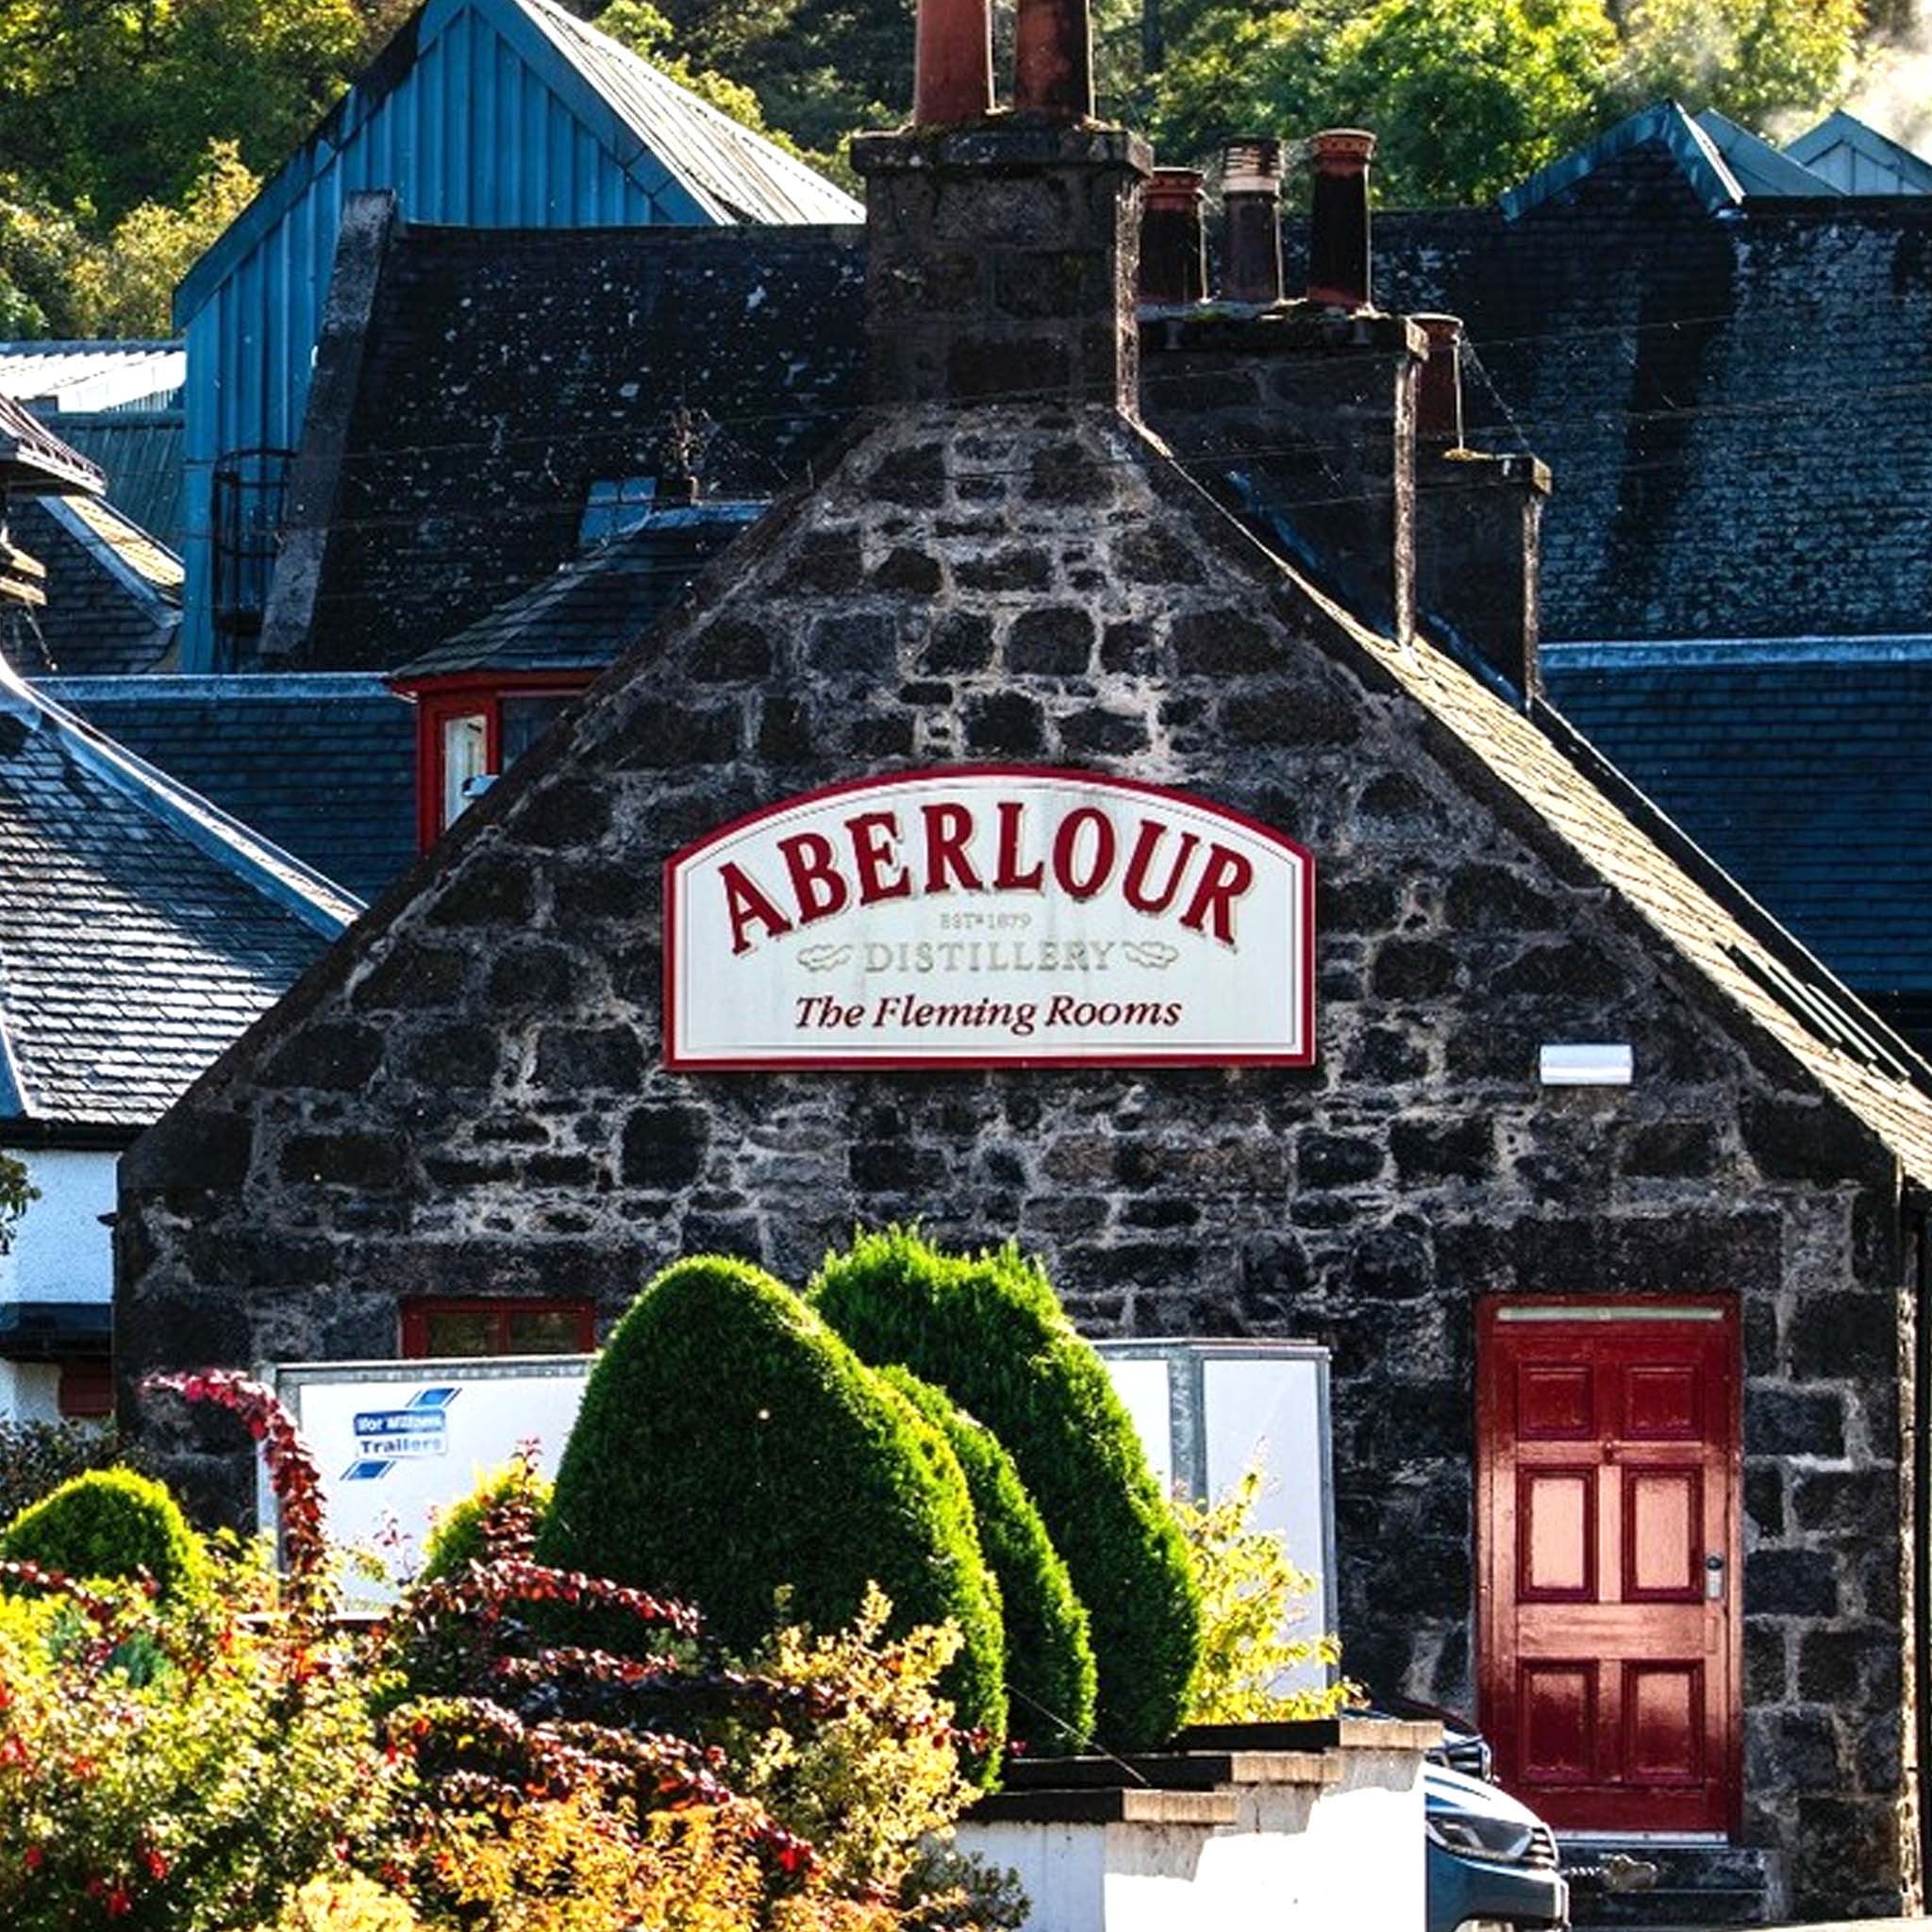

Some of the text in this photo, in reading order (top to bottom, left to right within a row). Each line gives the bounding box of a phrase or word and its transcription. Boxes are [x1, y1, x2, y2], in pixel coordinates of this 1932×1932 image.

[718, 802, 1254, 954] ABERLOUR
[864, 941, 1116, 973] DISTILLERY
[795, 994, 1183, 1036] The Fleming Rooms
[360, 1439, 441, 1453] Trailers
